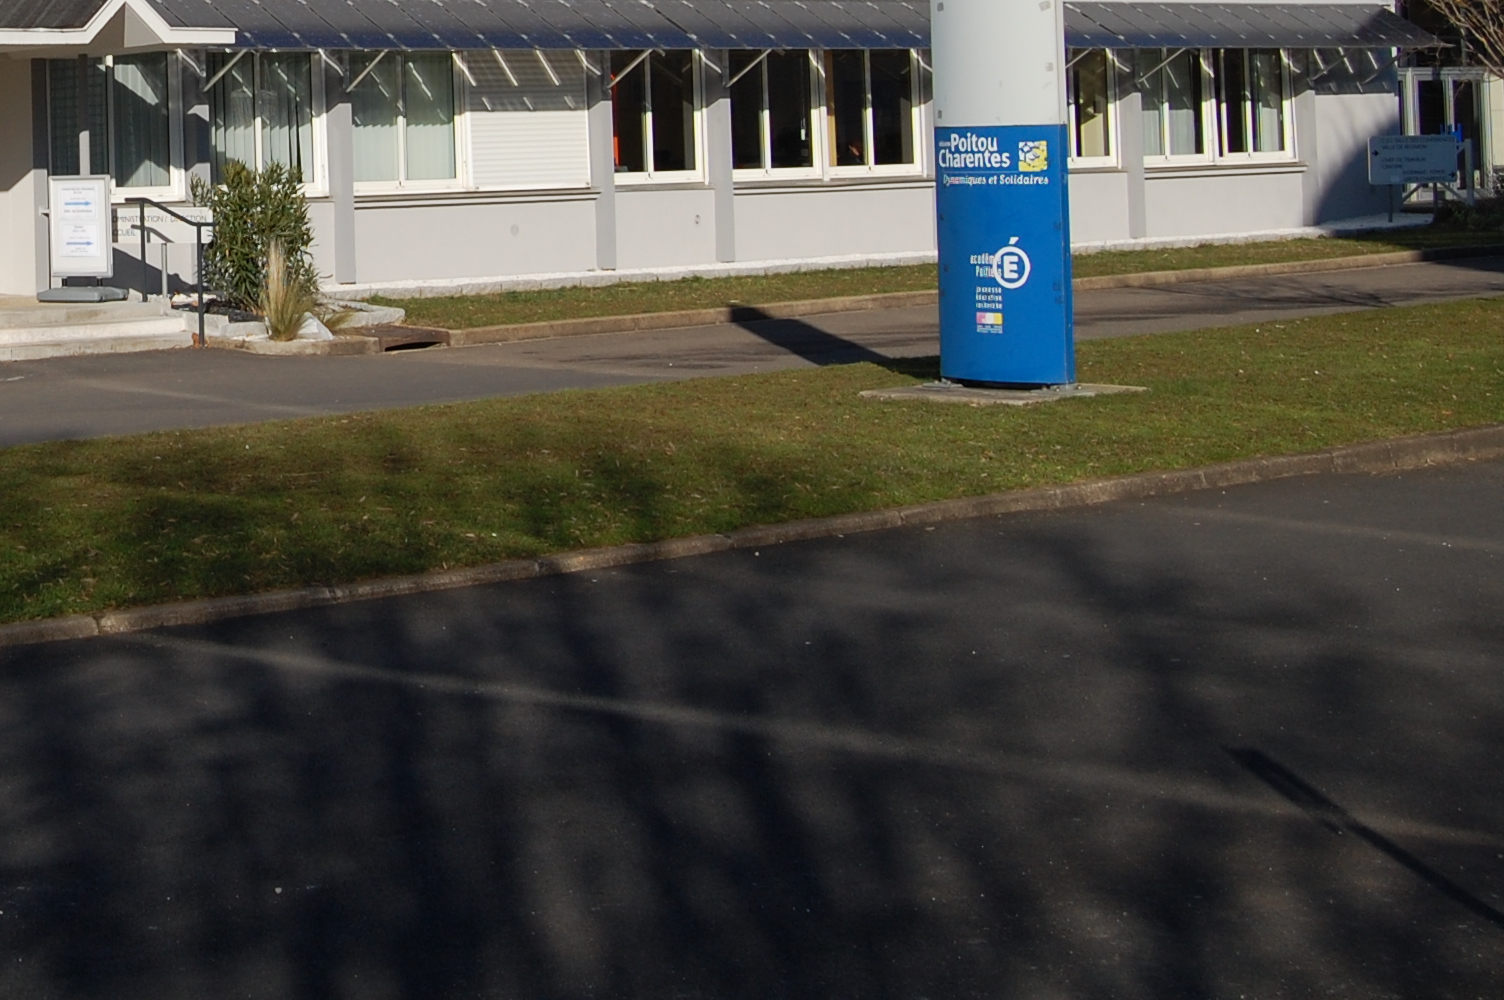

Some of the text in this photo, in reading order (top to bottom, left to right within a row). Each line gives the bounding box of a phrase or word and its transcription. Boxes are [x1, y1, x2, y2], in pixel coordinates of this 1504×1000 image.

[950, 131, 998, 152] Poitou
[938, 149, 1011, 168] Charentes
[999, 174, 1049, 185] Solidaires
